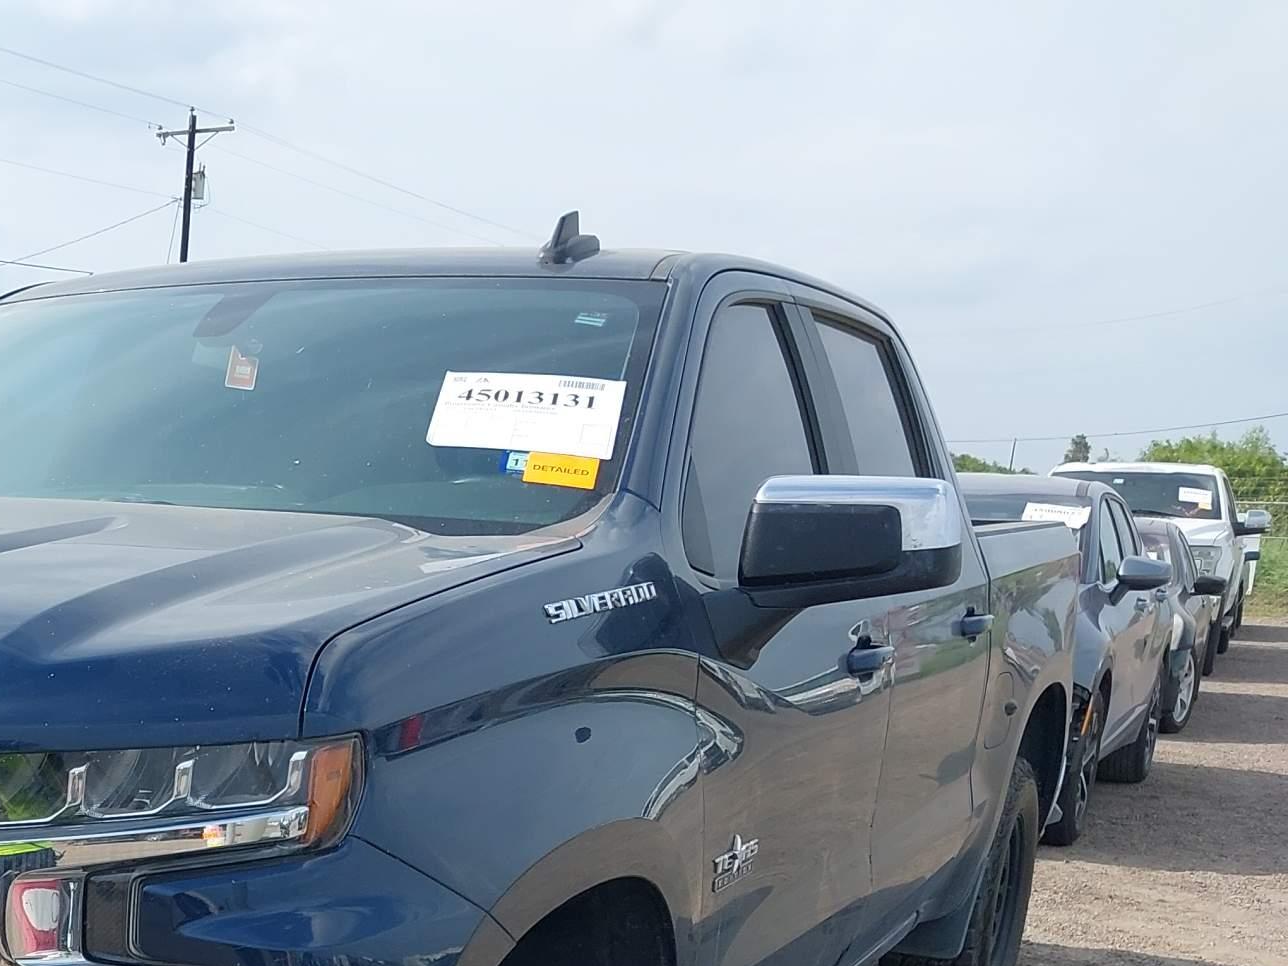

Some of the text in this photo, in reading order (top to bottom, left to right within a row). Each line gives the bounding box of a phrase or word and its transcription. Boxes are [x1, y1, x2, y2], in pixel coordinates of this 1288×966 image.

[457, 388, 596, 409] 45013131
[533, 464, 590, 476] DETAILED
[544, 581, 658, 623] SILVERADO
